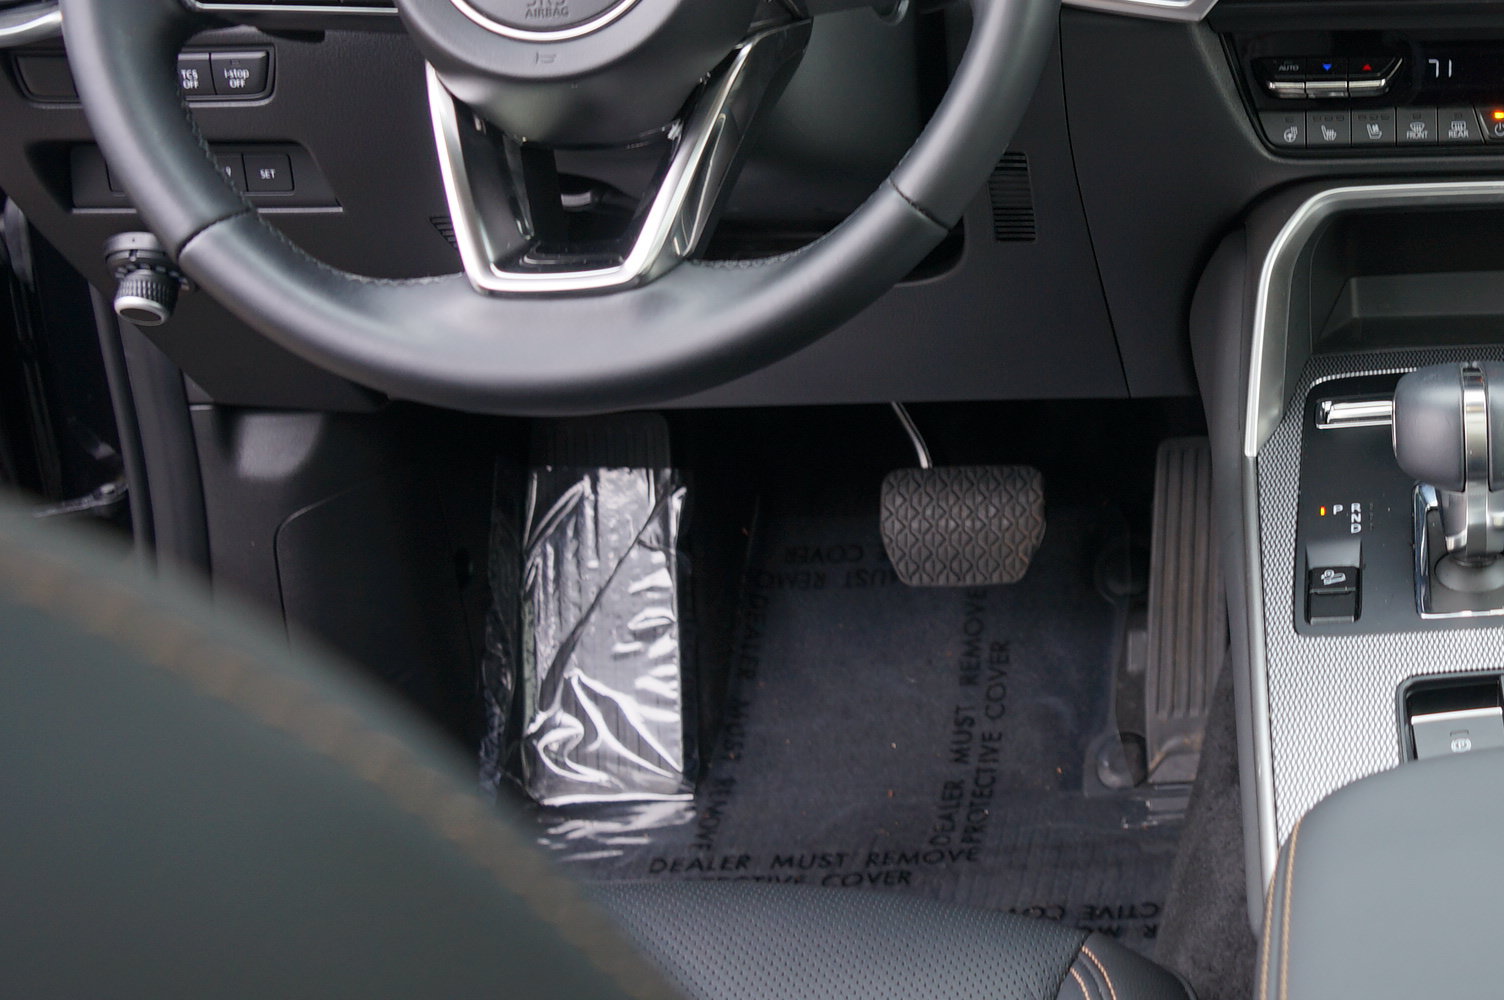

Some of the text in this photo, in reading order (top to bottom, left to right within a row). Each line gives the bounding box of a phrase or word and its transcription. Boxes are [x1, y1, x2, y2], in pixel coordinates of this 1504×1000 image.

[525, 6, 569, 19] AIRBAG
[1428, 58, 1452, 78] 71
[183, 79, 199, 89] OFF
[229, 78, 245, 88] OFF
[1406, 130, 1428, 140] FRONT
[259, 168, 275, 179] SET
[1333, 504, 1344, 515] P
[1351, 502, 1361, 513] R
[1351, 513, 1361, 523] N
[1350, 523, 1362, 534] D
[929, 586, 987, 846] DEALER MUST REMOVE
[960, 639, 1011, 845] PROTECTIVE COVER
[649, 846, 983, 876] DEALER MUST REMOVE
[821, 869, 914, 888] COVER
